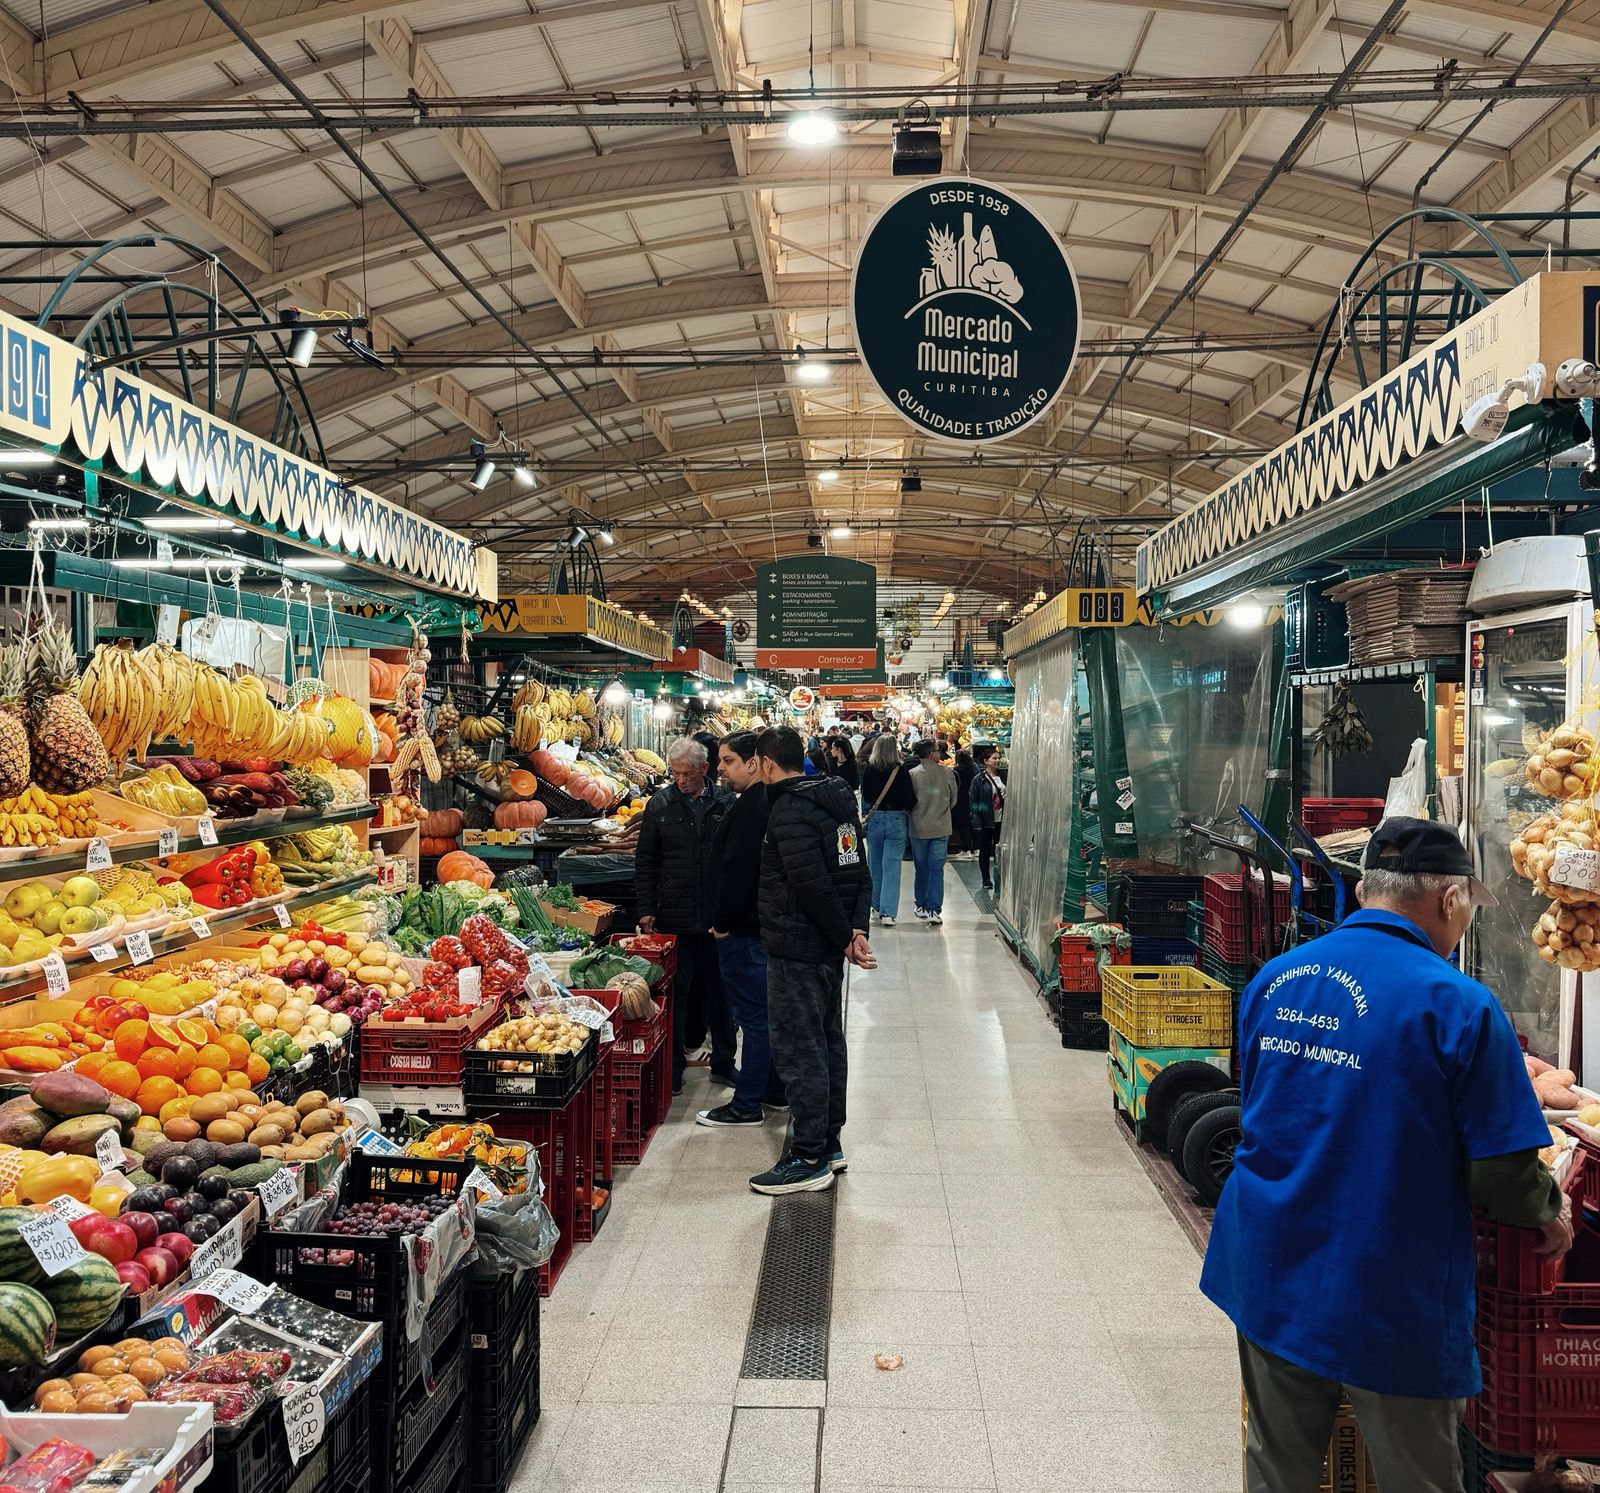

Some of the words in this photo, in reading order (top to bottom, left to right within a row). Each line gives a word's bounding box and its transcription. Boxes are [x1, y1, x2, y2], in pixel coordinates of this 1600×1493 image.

[929, 190, 975, 205] DESDE
[978, 194, 1010, 216] 1958
[925, 308, 1013, 343] Mercado
[917, 342, 1018, 381] Municipal
[924, 381, 1010, 397] CURITIBA
[897, 388, 972, 436] QUALIDADE
[975, 423, 984, 436] E
[985, 387, 1048, 434] TRADIÇÃO
[1082, 596, 1120, 619] 083
[769, 653, 778, 665] C
[818, 655, 855, 665] Corredor
[857, 655, 864, 664] 2
[1264, 964, 1320, 1000] YOSHIHIRO
[1325, 966, 1369, 1018] YAMASAKI
[1165, 1015, 1203, 1024] CITROESTE
[1275, 1007, 1340, 1031] 3264-4533
[390, 1054, 410, 1068] COSTA
[411, 1055, 431, 1069] MELLO
[1303, 1043, 1362, 1070] MUNICIPAL
[20, 1214, 60, 1234] MELANCIA
[29, 1228, 55, 1248] BABY
